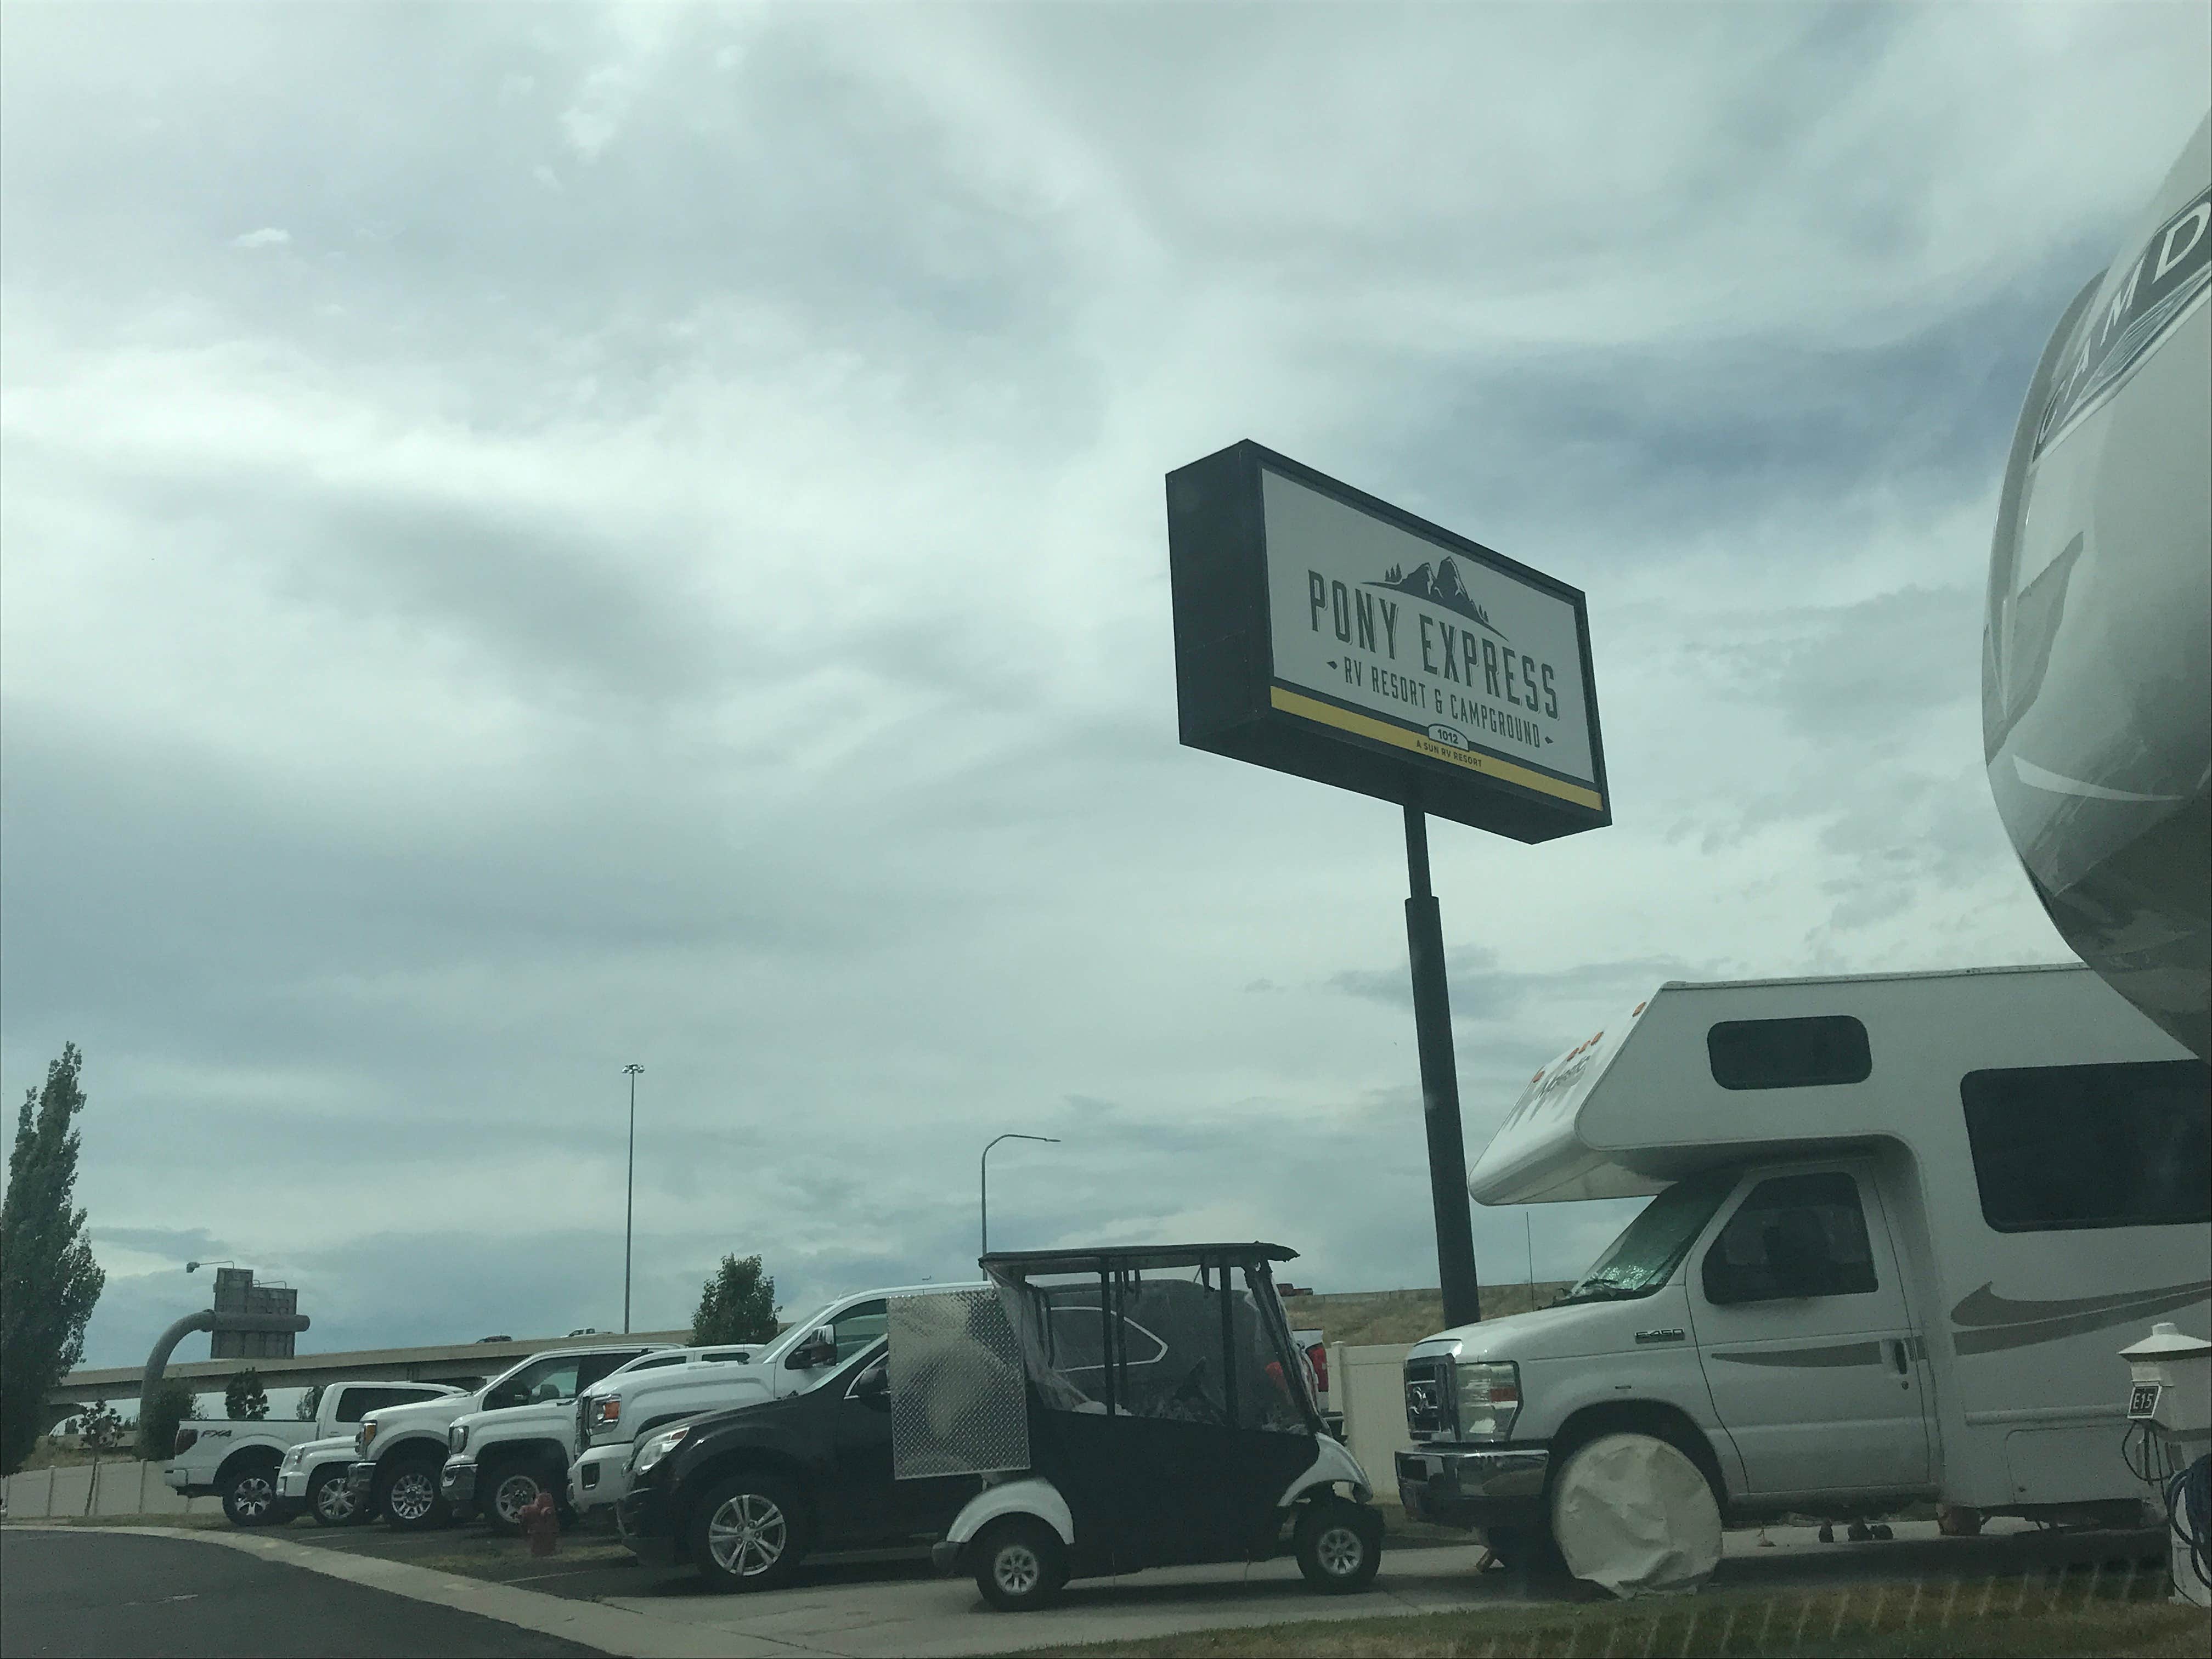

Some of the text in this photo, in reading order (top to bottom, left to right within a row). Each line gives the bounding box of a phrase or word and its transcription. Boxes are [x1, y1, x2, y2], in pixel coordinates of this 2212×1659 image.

[1308, 569, 1560, 721] PONY EXPRESS
[1344, 656, 1540, 748] RV RESORT & CAMPGROUND
[1437, 729, 1458, 744] 1012
[1417, 740, 1482, 767] A SUN RV RESORT
[2132, 1393, 2154, 1409] E15
